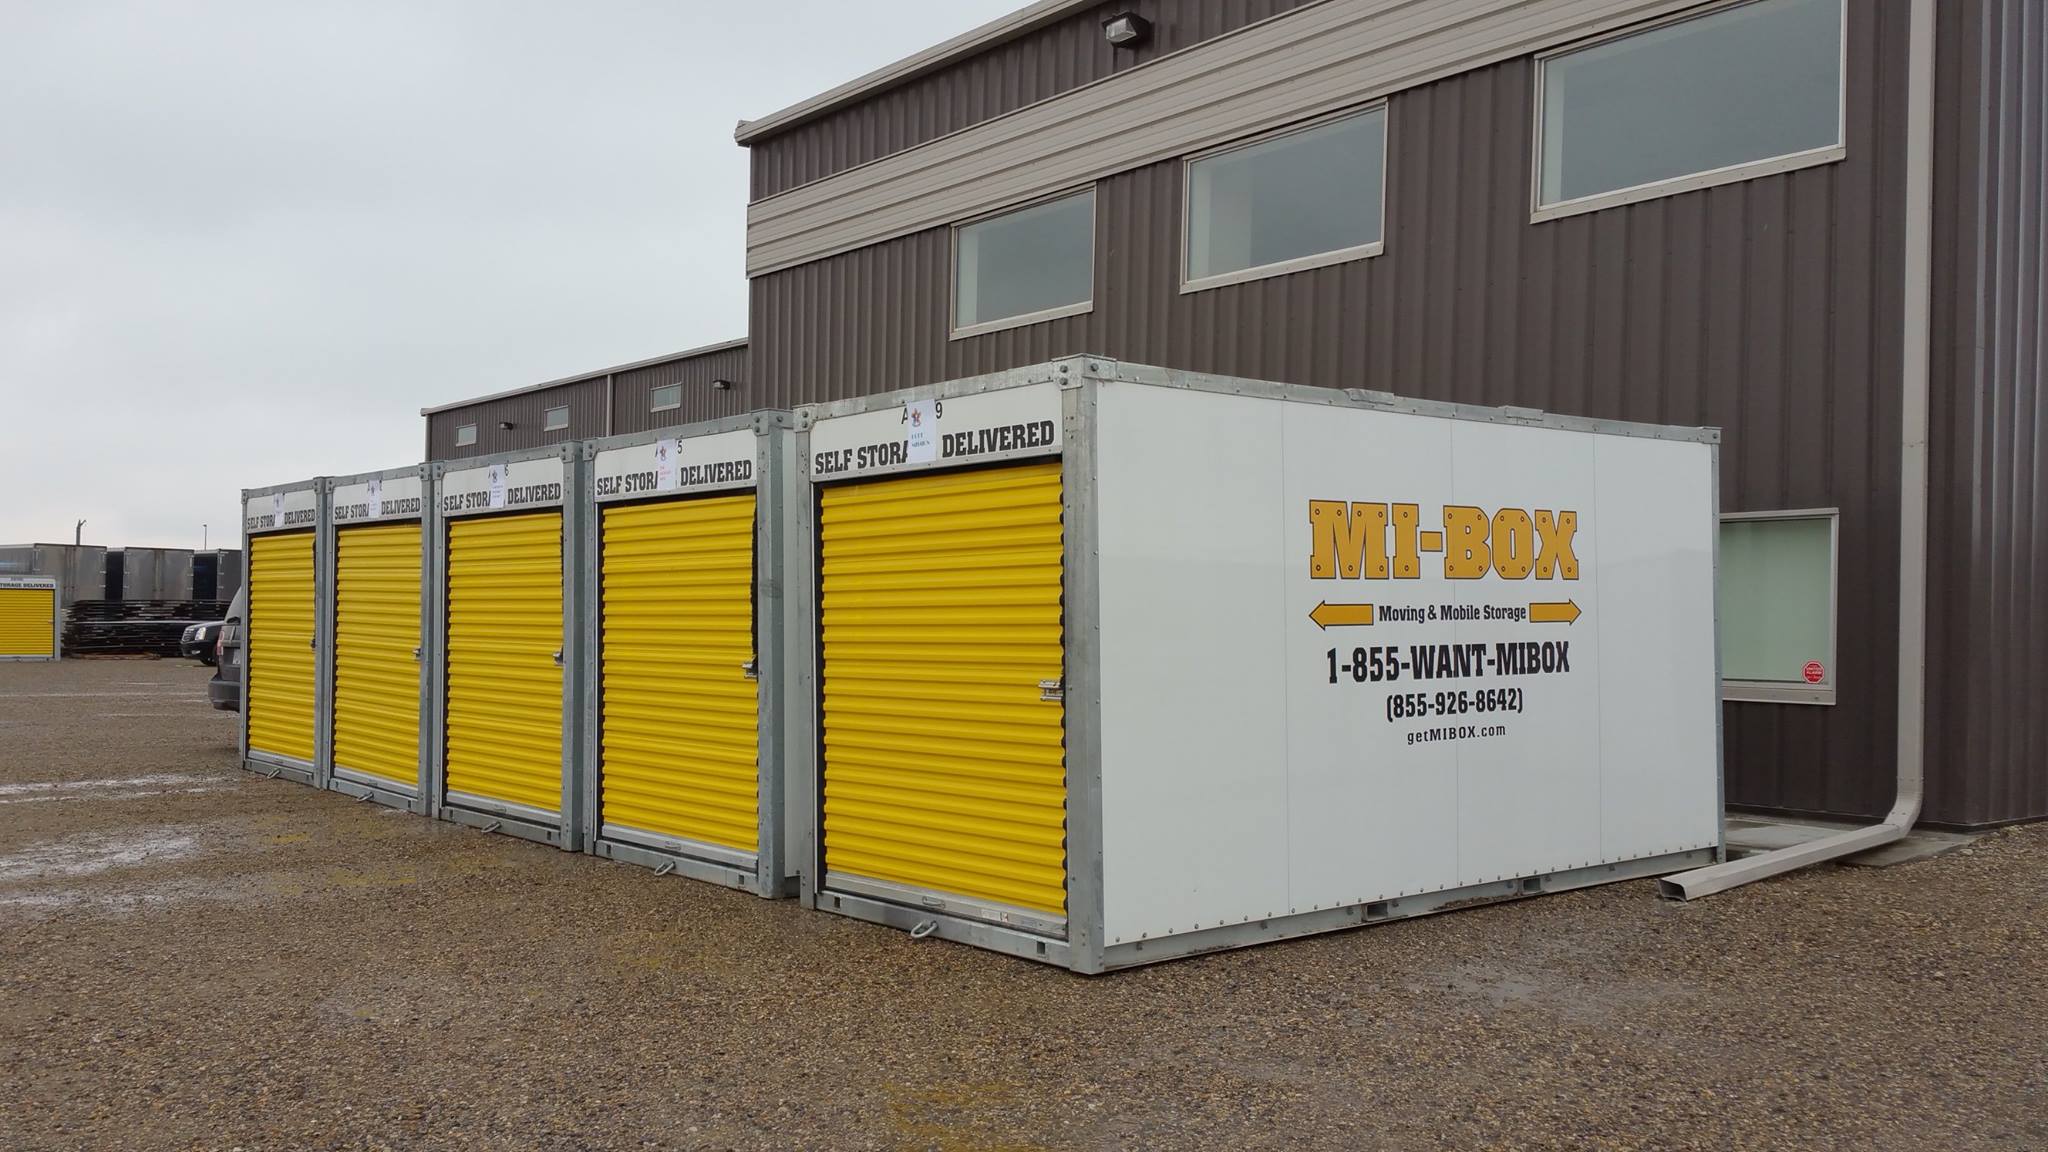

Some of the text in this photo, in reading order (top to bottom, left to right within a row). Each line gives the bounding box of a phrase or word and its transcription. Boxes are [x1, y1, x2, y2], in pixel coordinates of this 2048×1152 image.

[815, 448, 852, 475] SELF
[942, 419, 1055, 458] DELIVERED
[596, 475, 622, 496] SELF
[680, 459, 752, 486] DELIVERED
[334, 505, 350, 520] SELF
[381, 497, 421, 515] DELIVERED
[443, 494, 464, 511] SELF
[507, 482, 561, 505] DELIVERED
[247, 517, 259, 530] SELF
[284, 508, 316, 525] DELIVERED
[1309, 499, 1579, 580] MI-BOX
[1379, 604, 1526, 624] Moving & Mobile Storage
[1327, 641, 1570, 684] 1-855-WANT-MIBOX
[1386, 687, 1523, 722] (855-926-8642)
[1407, 724, 1506, 745] getMIBOX.com
